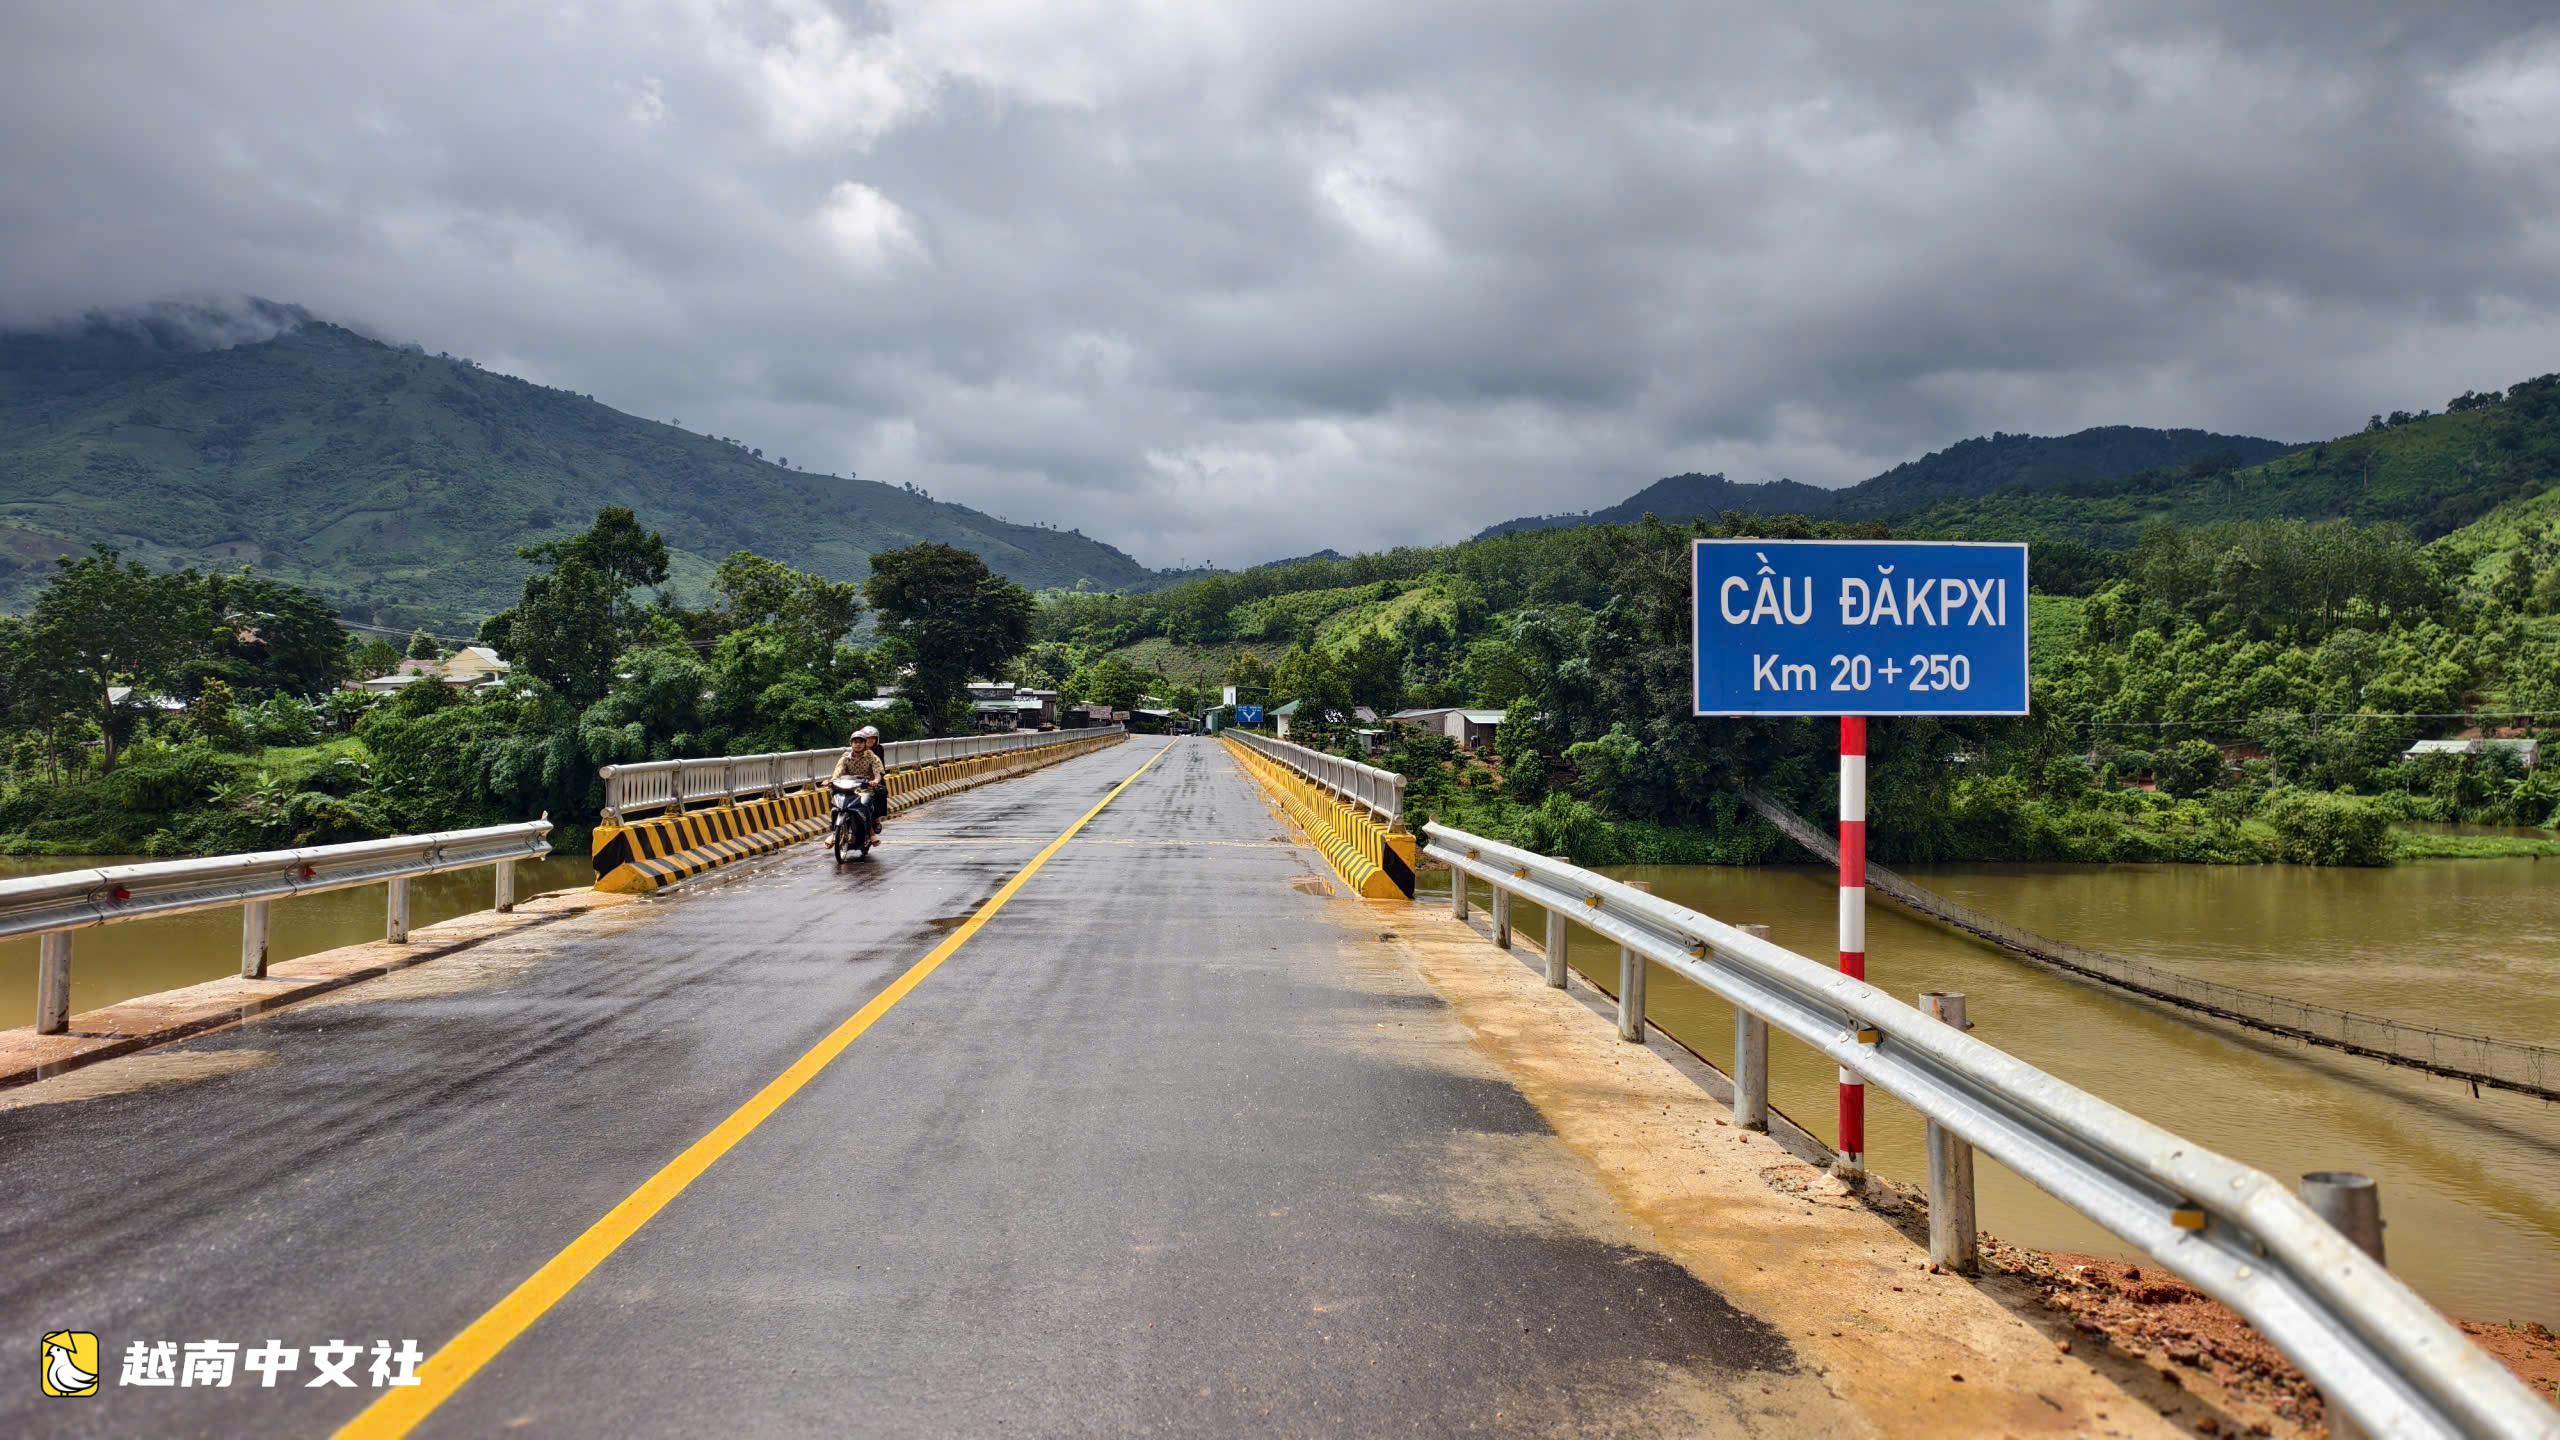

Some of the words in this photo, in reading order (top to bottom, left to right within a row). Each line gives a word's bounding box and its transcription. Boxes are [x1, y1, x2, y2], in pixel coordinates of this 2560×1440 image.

[1720, 552, 1813, 625] CẦU
[1839, 564, 2007, 626] ĐĂKPXI
[1753, 654, 1817, 692] Km
